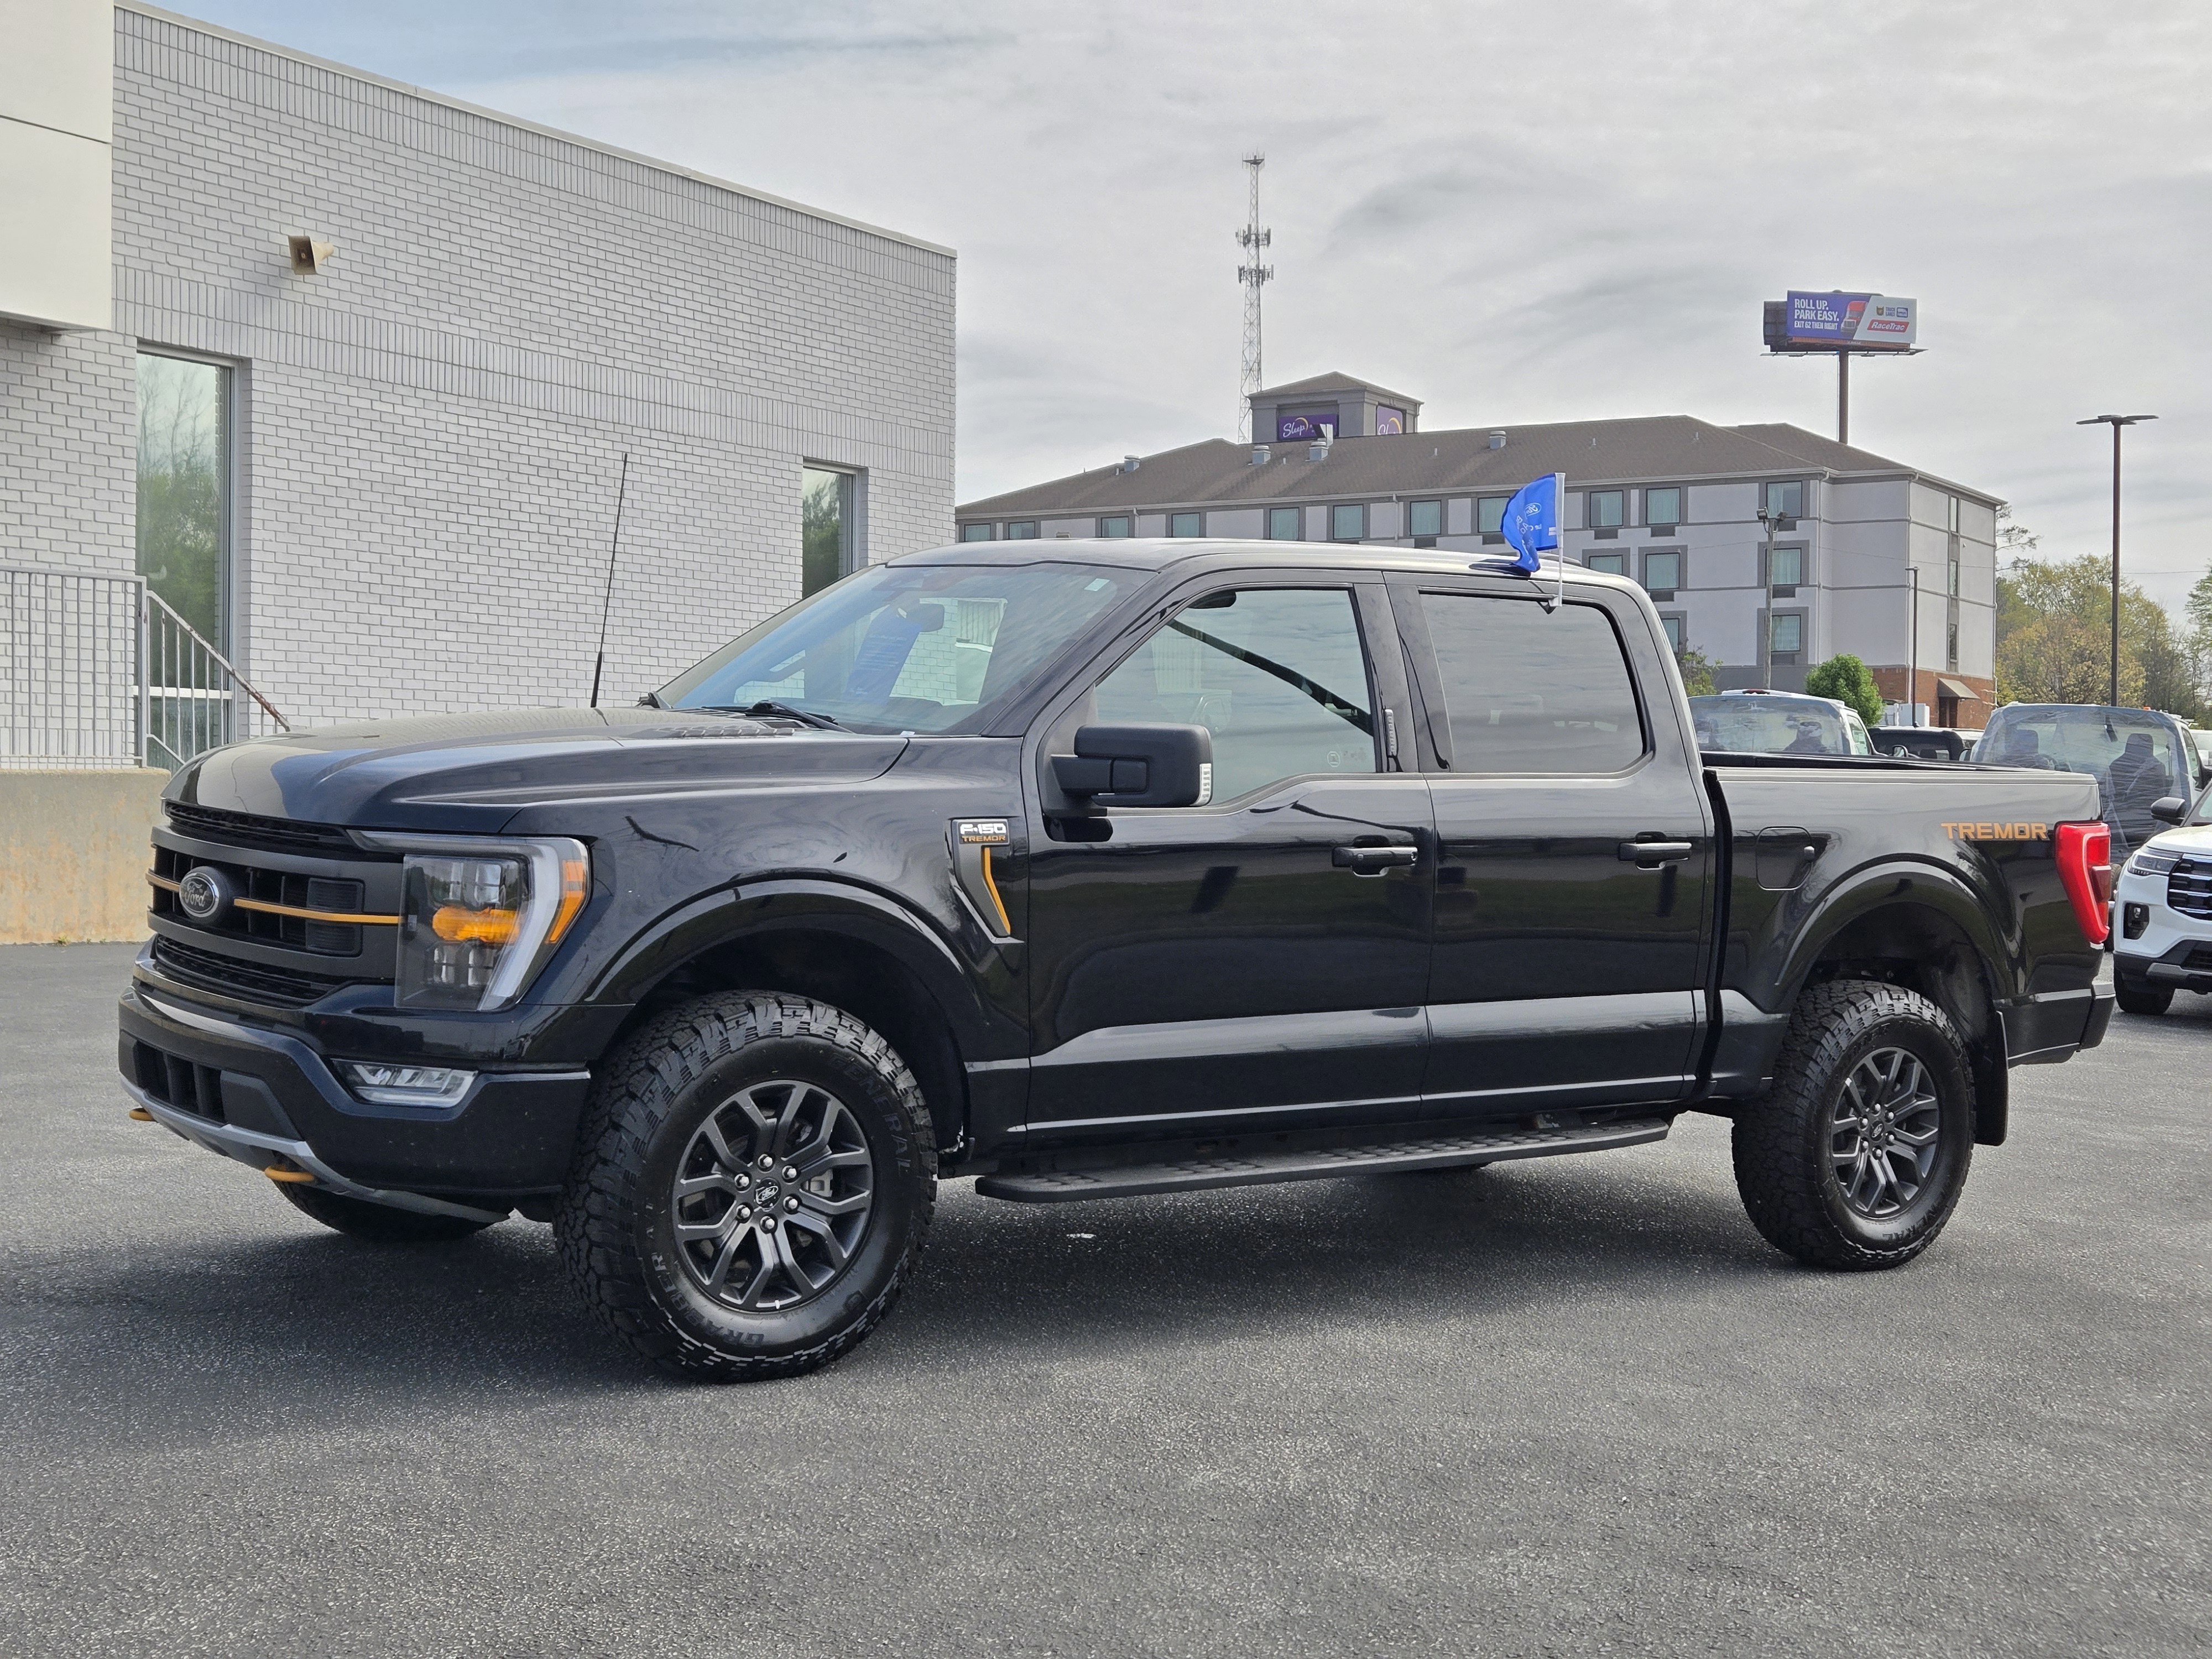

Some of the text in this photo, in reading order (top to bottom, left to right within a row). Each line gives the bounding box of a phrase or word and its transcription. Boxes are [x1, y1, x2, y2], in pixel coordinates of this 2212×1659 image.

[1794, 299, 1829, 310] ROLL UP.
[1794, 309, 1839, 321] PARK EASY.
[1871, 321, 1905, 330] RaceTrac
[1283, 422, 1306, 437] Sleep
[960, 823, 1006, 834] F-150
[1940, 822, 2049, 840] TREMOR
[184, 881, 207, 907] Ford
[651, 1252, 764, 1348] GRABBER
